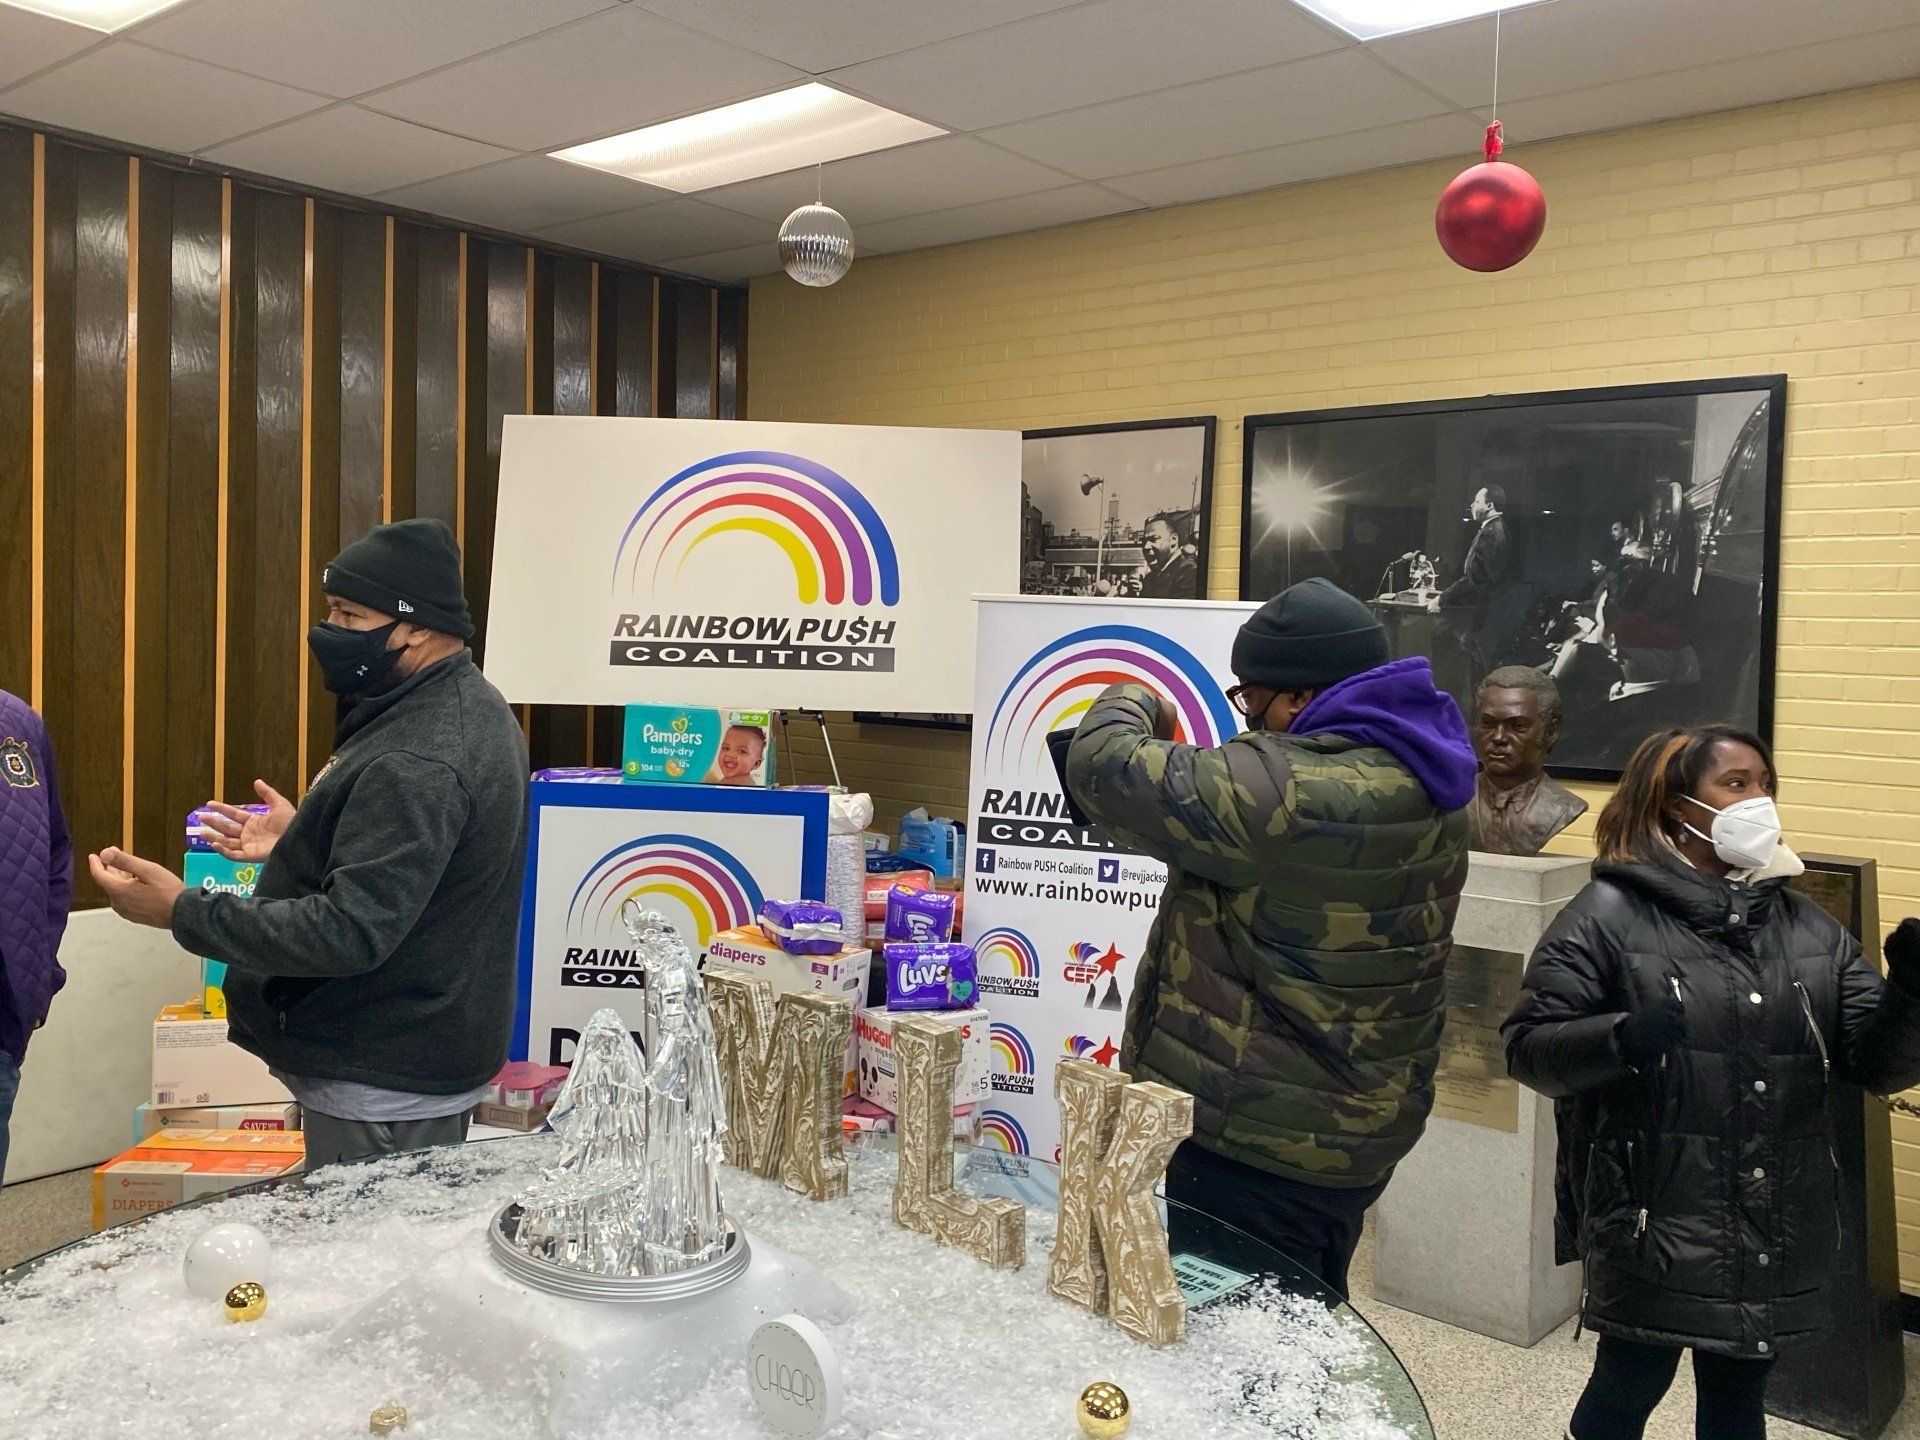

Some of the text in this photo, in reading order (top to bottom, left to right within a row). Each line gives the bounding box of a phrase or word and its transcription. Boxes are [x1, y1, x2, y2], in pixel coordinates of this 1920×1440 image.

[613, 613, 790, 641] RAINBOW
[625, 646, 875, 667] COALITION
[643, 723, 703, 746] Pampers
[650, 746, 695, 757] baby-dry
[629, 762, 636, 771] 3
[998, 857, 1032, 871] Rainbow
[1034, 860, 1056, 873] PUSH
[1058, 862, 1094, 876] Coalition
[975, 878, 1160, 911] www.rainbowpu
[709, 942, 766, 966] diapers
[1063, 966, 1099, 984] CEF
[815, 979, 822, 990] 2
[217, 1000, 225, 1009] 2
[980, 1077, 988, 1090] 5
[1175, 1268, 1199, 1282] TAB
